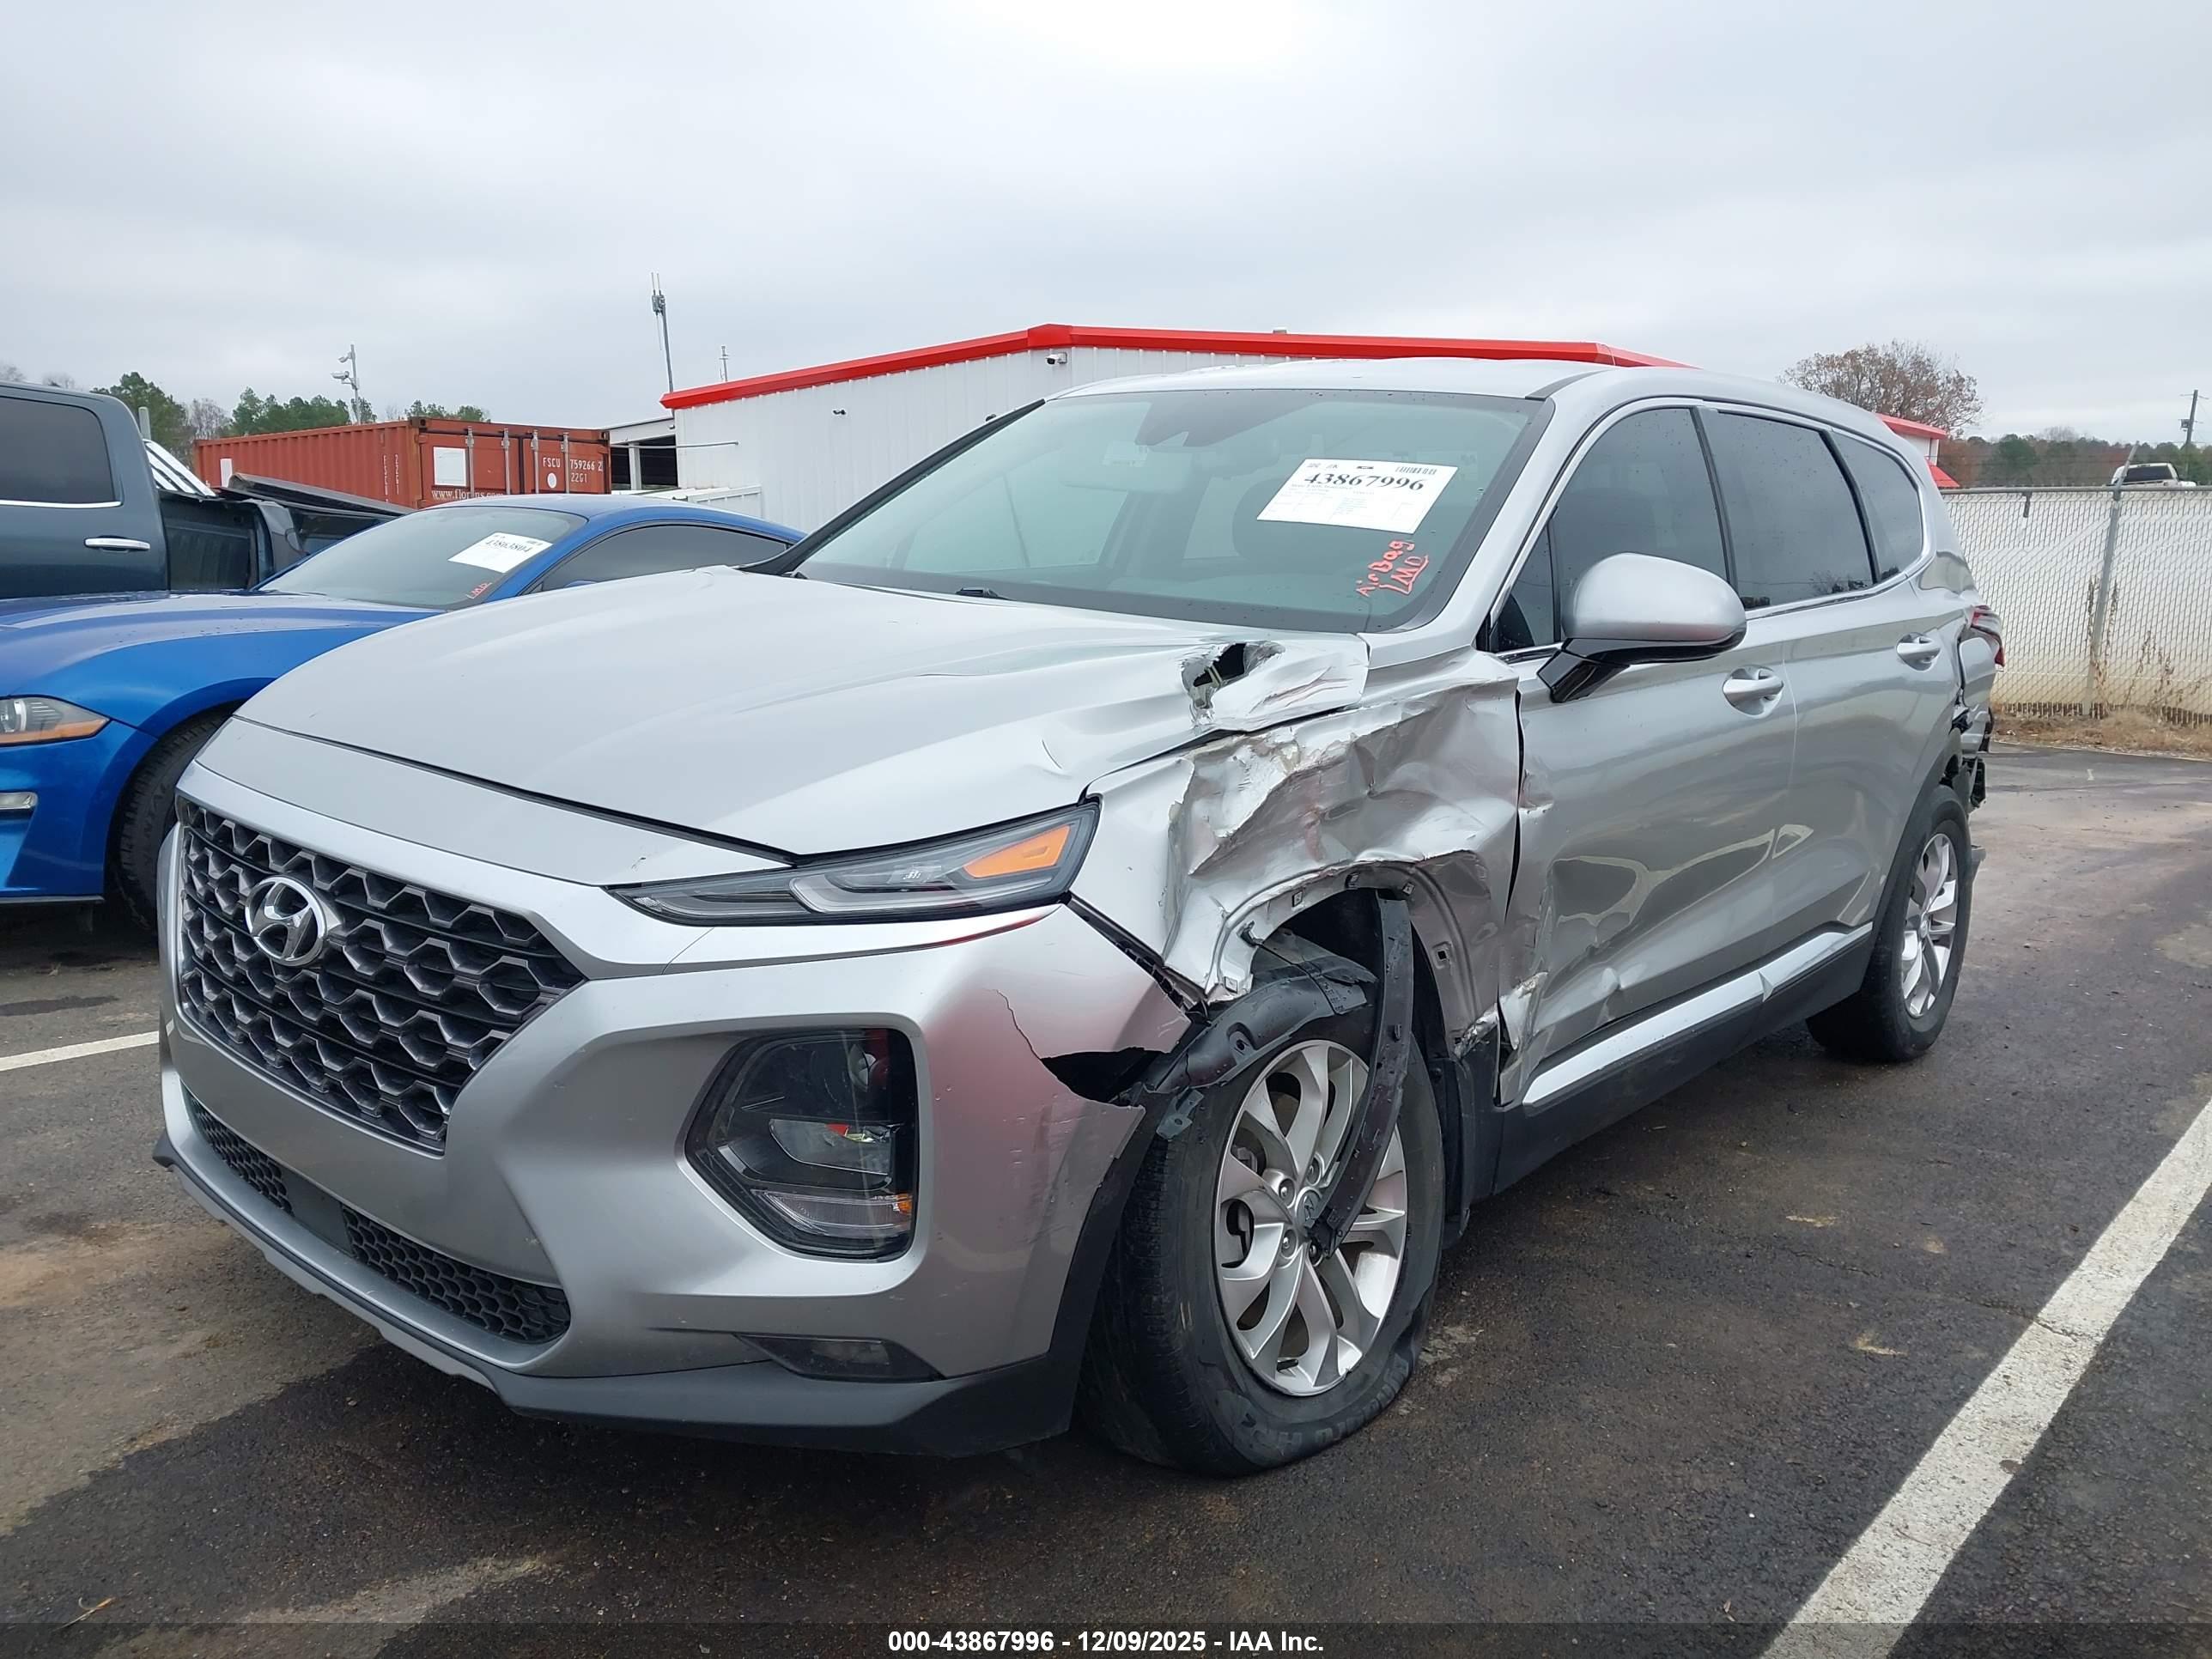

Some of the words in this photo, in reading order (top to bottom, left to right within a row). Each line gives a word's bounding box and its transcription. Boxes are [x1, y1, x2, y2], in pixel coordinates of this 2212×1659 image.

[543, 457, 561, 468] FSCU
[570, 459, 595, 471] 759266
[571, 472, 587, 483] 22G1
[1304, 471, 1429, 492] 43867996
